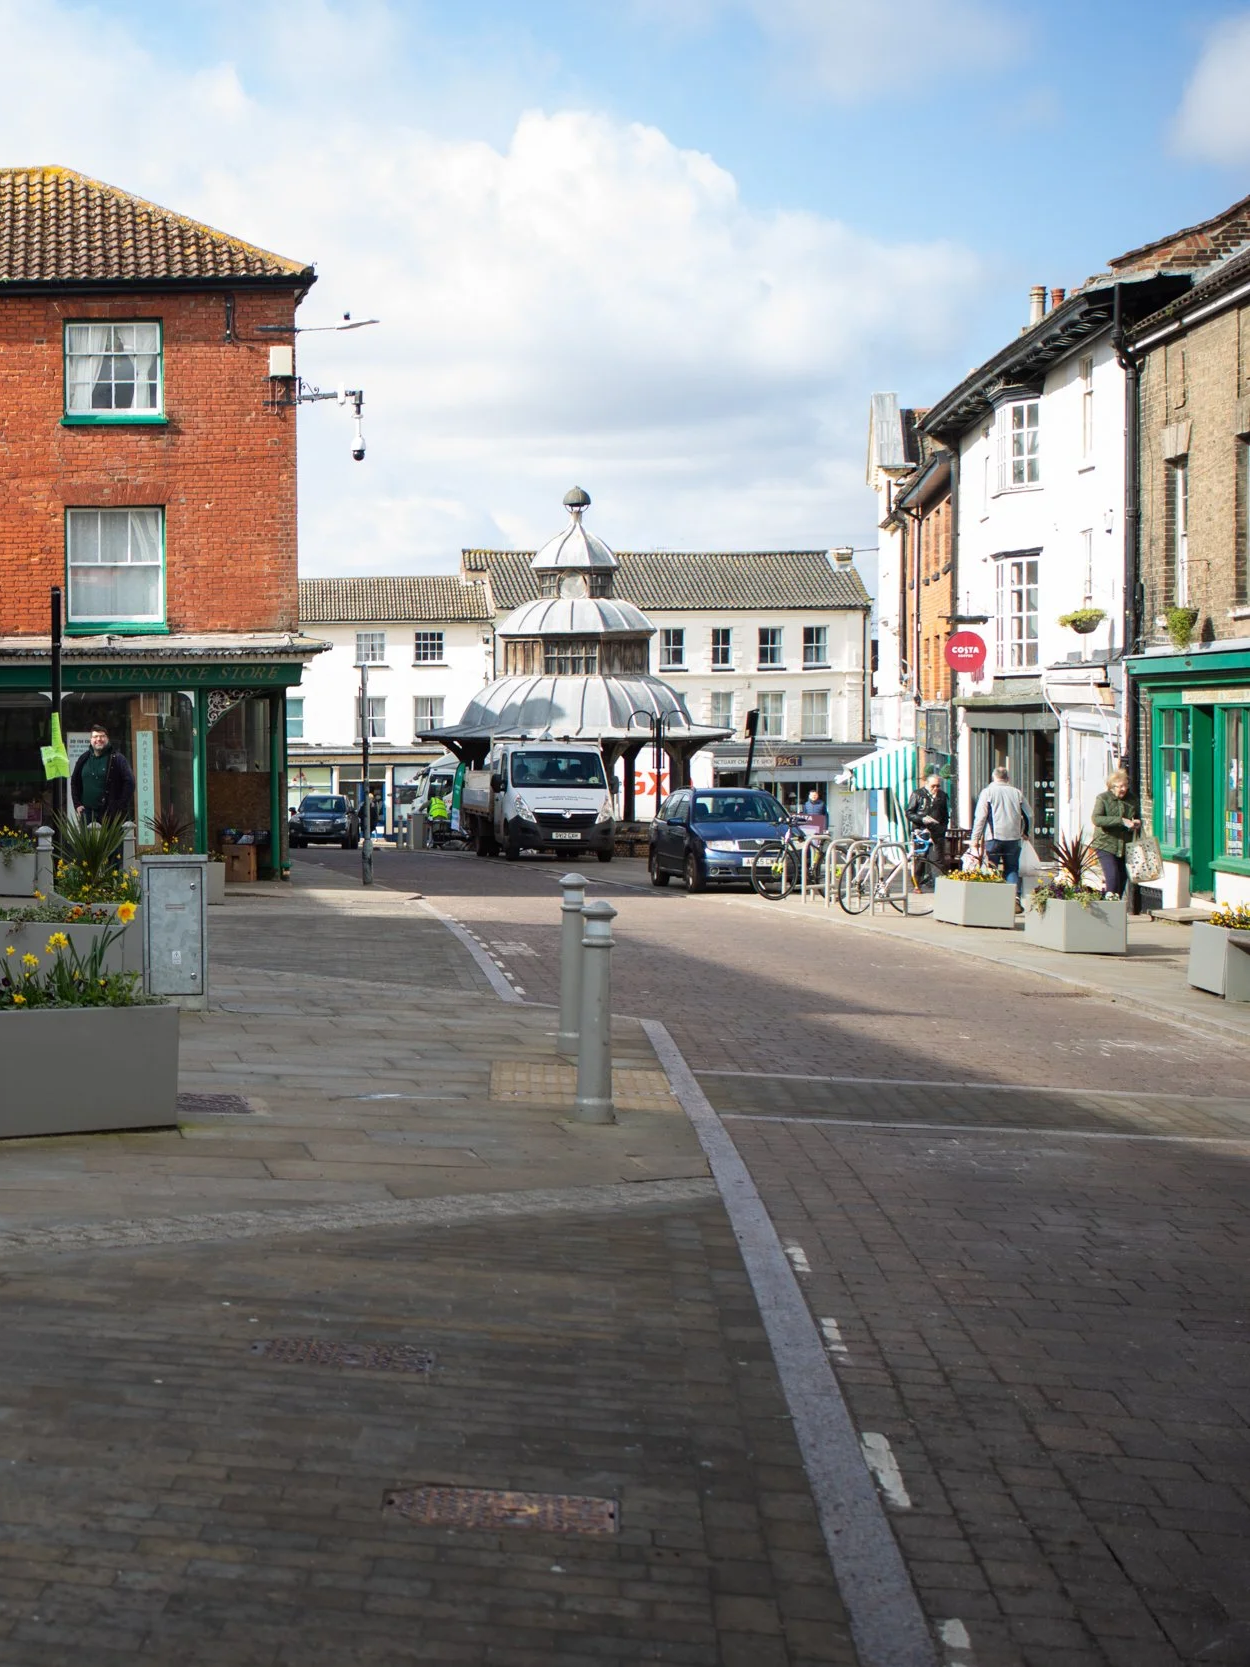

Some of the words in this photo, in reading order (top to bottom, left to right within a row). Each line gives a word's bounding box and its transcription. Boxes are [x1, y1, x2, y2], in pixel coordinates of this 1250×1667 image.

[951, 646, 980, 654] COSTA
[76, 667, 210, 681] CONVENIENCE
[218, 666, 280, 680] STORE
[777, 756, 800, 766] PACT
